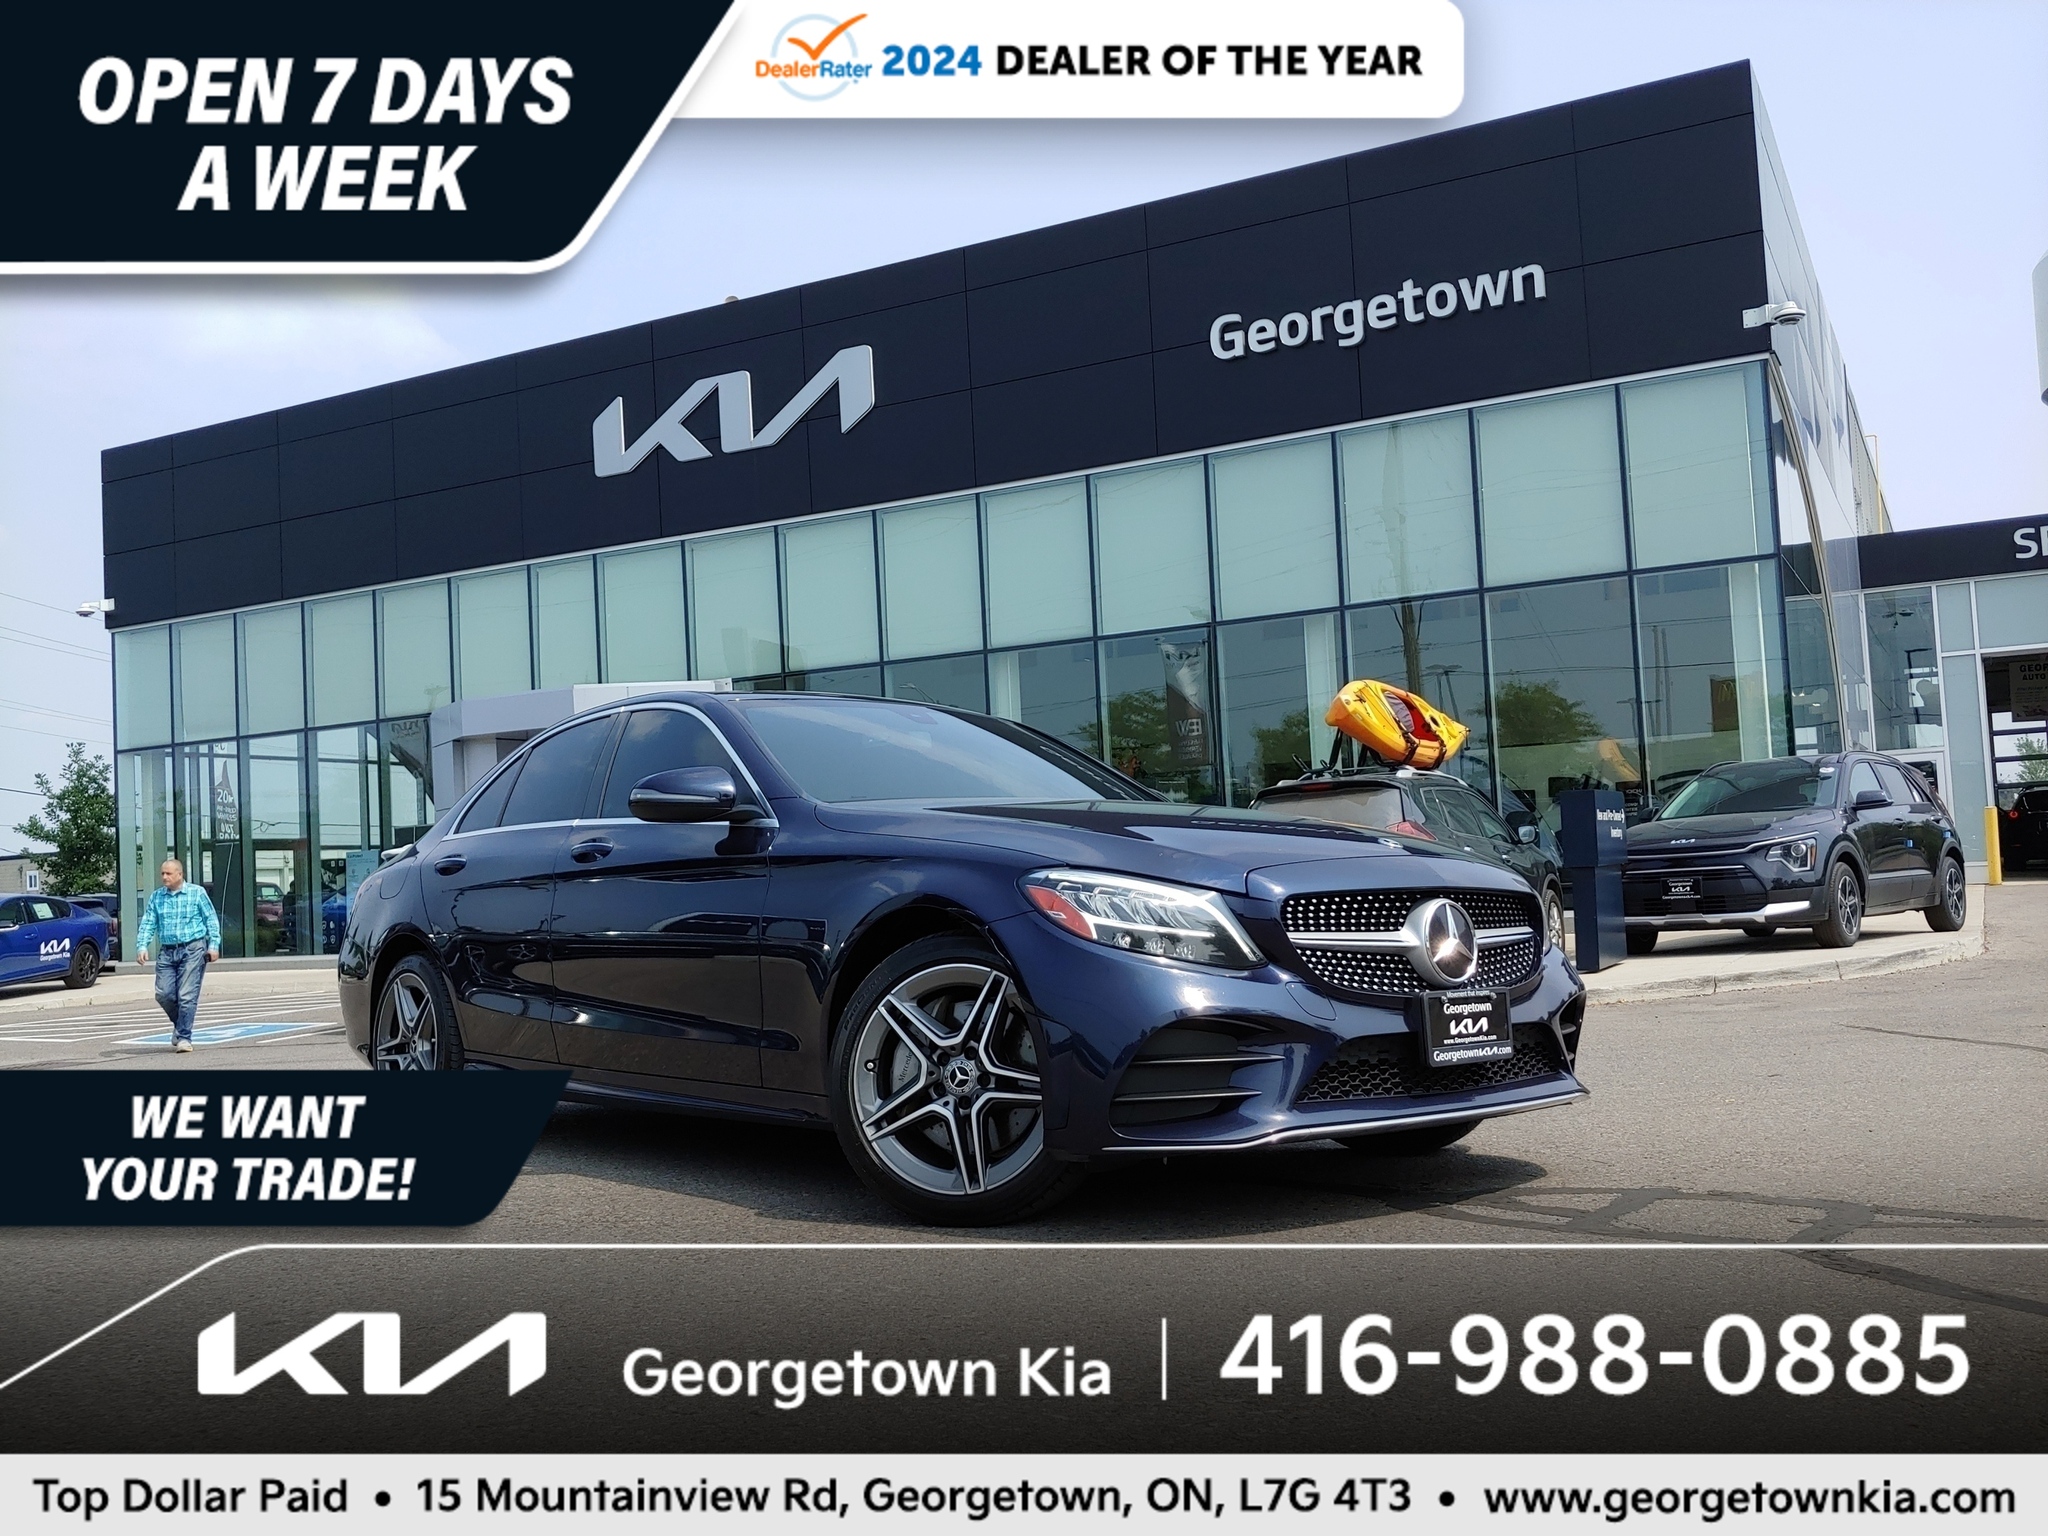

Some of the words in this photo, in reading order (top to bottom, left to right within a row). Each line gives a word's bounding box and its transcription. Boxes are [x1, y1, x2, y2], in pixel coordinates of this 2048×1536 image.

[1209, 264, 1547, 360] Georgetown
[592, 345, 876, 478] KIA
[40, 938, 70, 954] KIA
[1444, 1003, 1492, 1015] Georgetown
[1449, 1016, 1488, 1035] KIA
